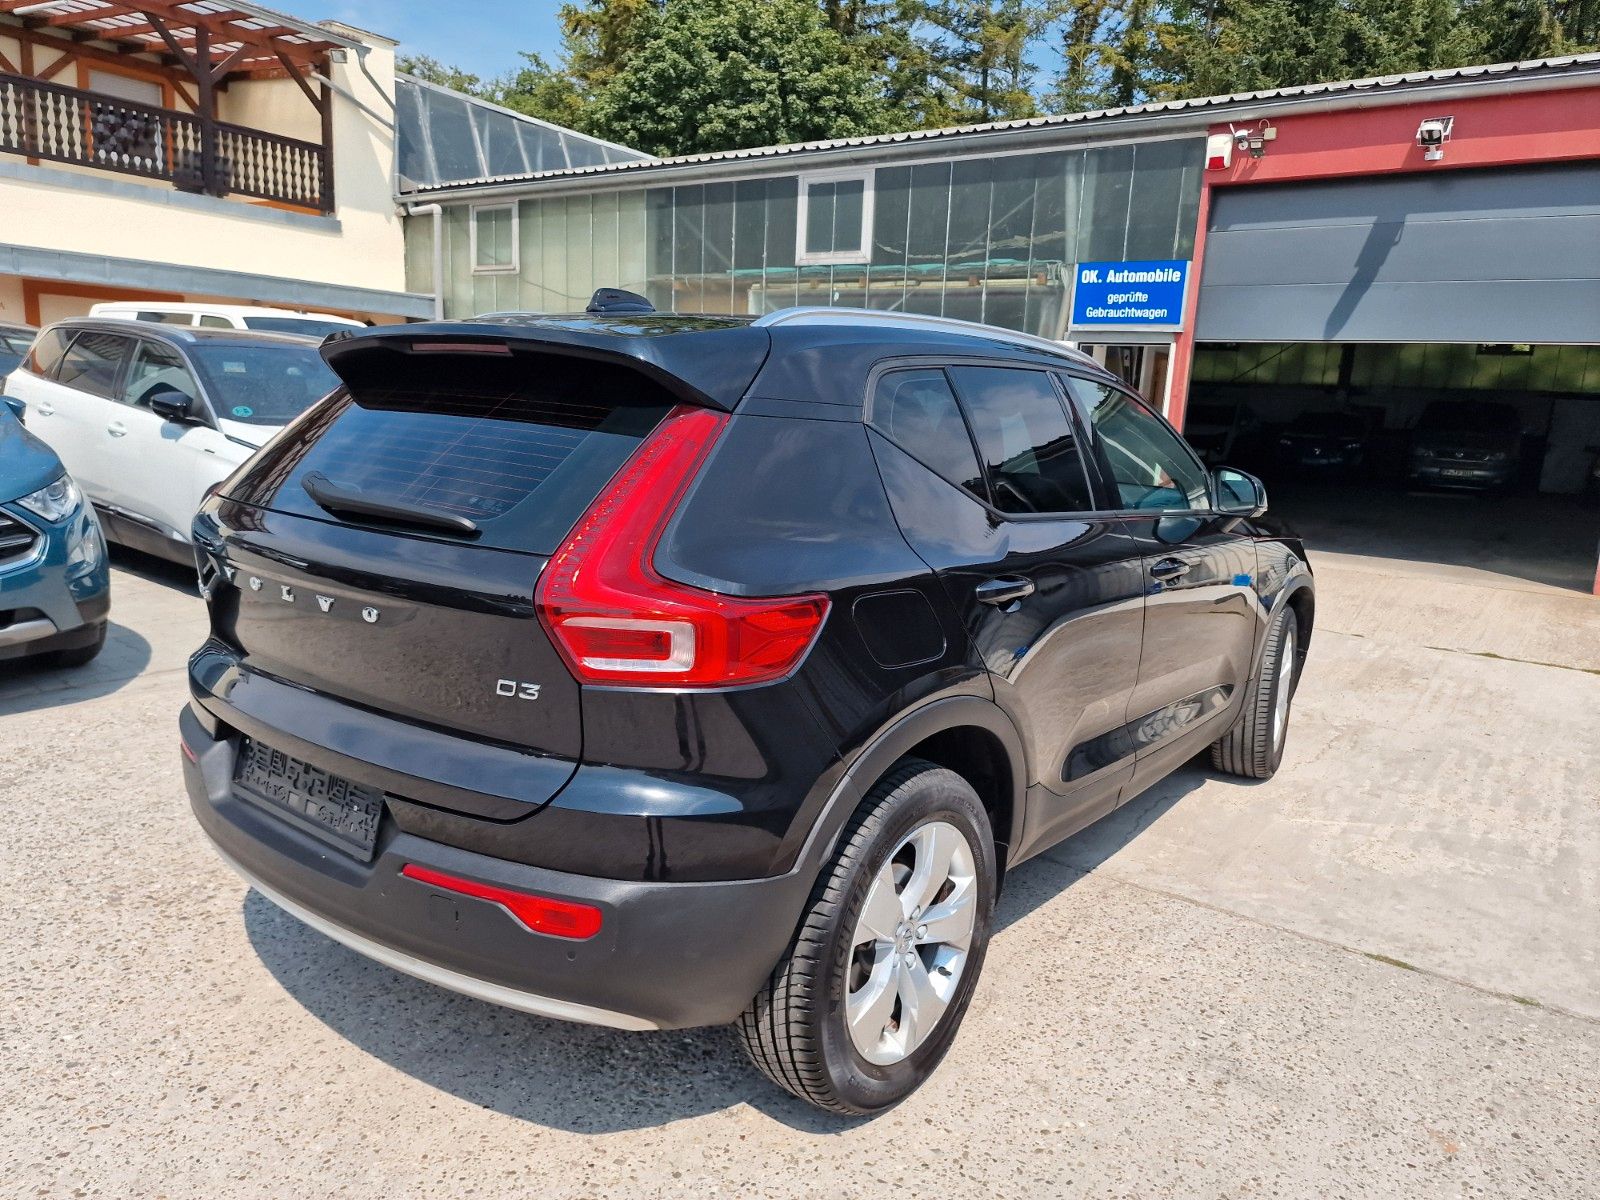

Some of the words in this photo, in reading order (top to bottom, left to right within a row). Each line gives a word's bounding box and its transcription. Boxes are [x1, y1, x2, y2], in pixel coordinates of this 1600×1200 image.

[1106, 268, 1181, 283] Automobile
[1107, 291, 1148, 304] geprüfte
[1086, 306, 1167, 319] Gebrauchtwagen
[223, 566, 379, 623] VOLVO
[496, 679, 541, 700] D3
